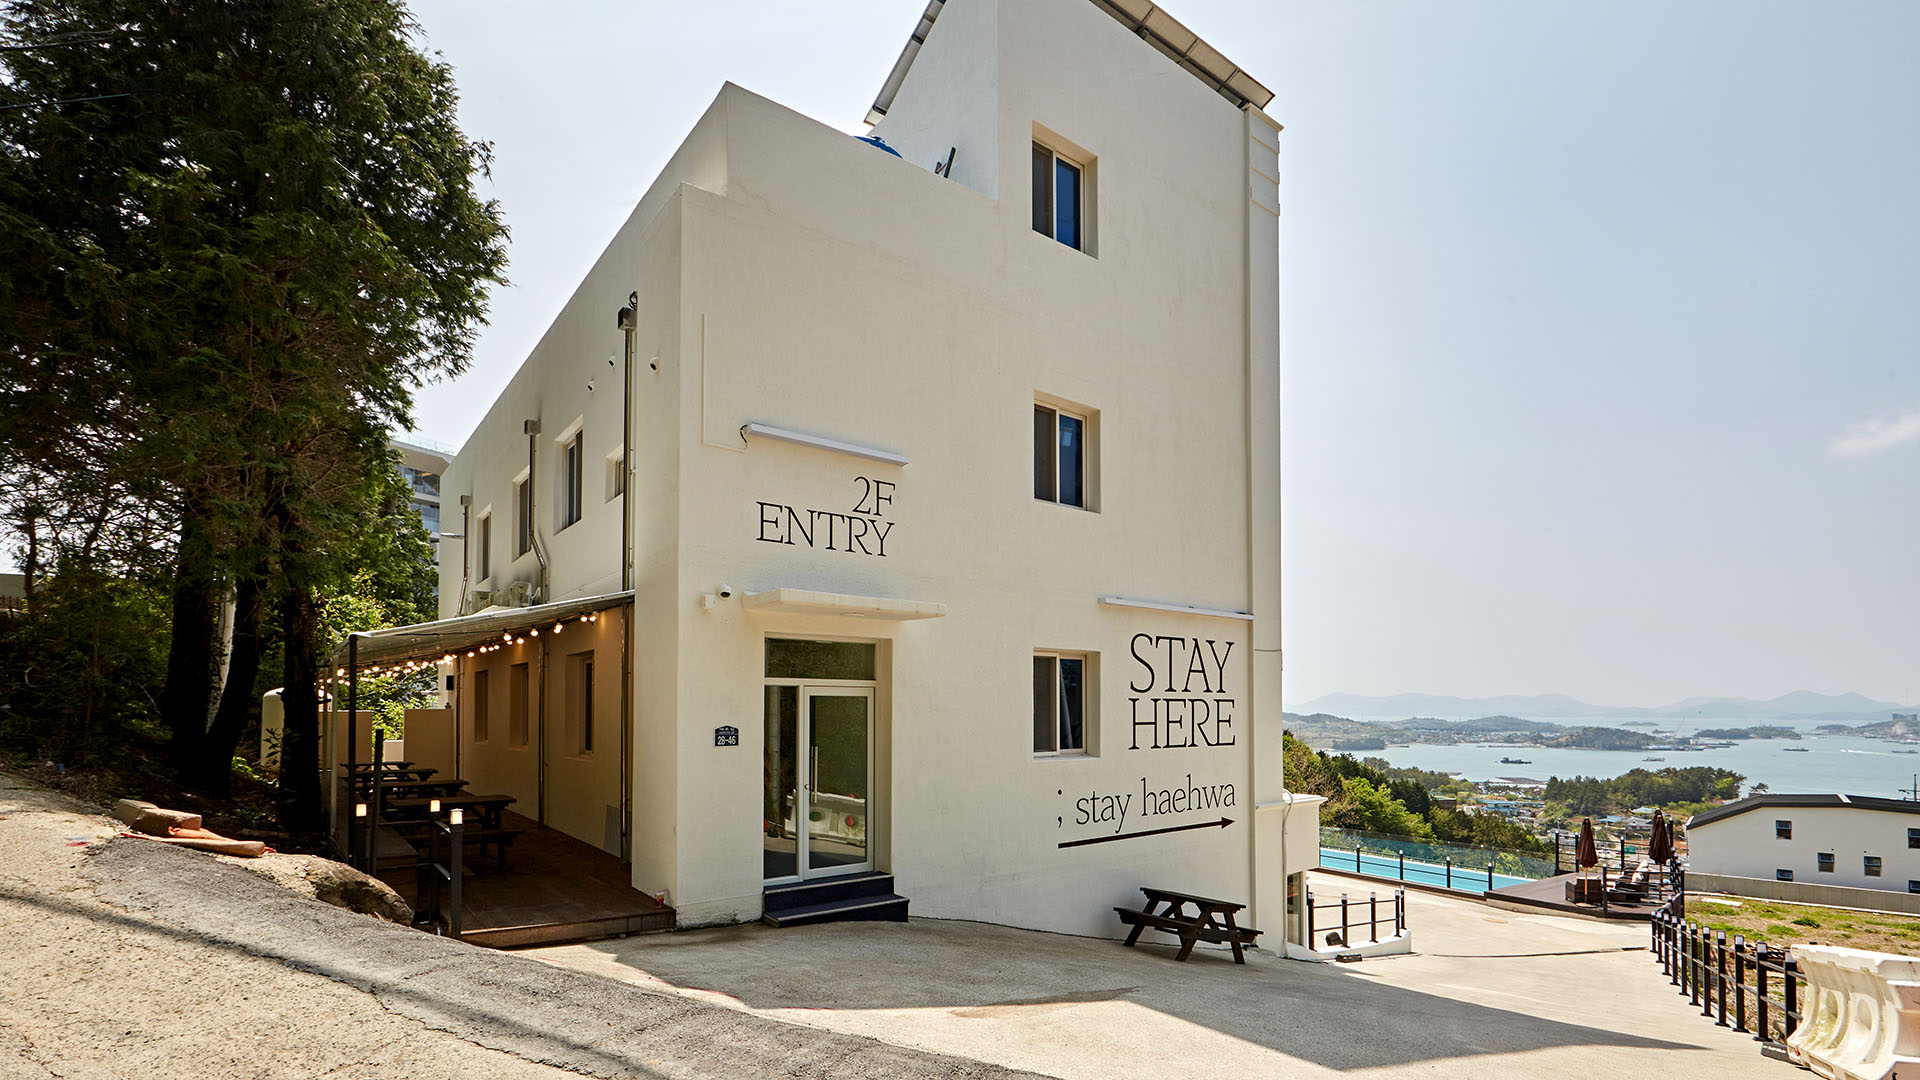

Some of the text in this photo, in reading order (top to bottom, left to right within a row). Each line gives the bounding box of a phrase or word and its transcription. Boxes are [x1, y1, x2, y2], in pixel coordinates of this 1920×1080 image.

[851, 476, 896, 516] 2F
[755, 501, 896, 557] ENTRY
[1129, 633, 1235, 693] STAY
[1128, 698, 1236, 750] HERE
[1075, 791, 1132, 834] stay
[1140, 774, 1236, 817] haehwa
